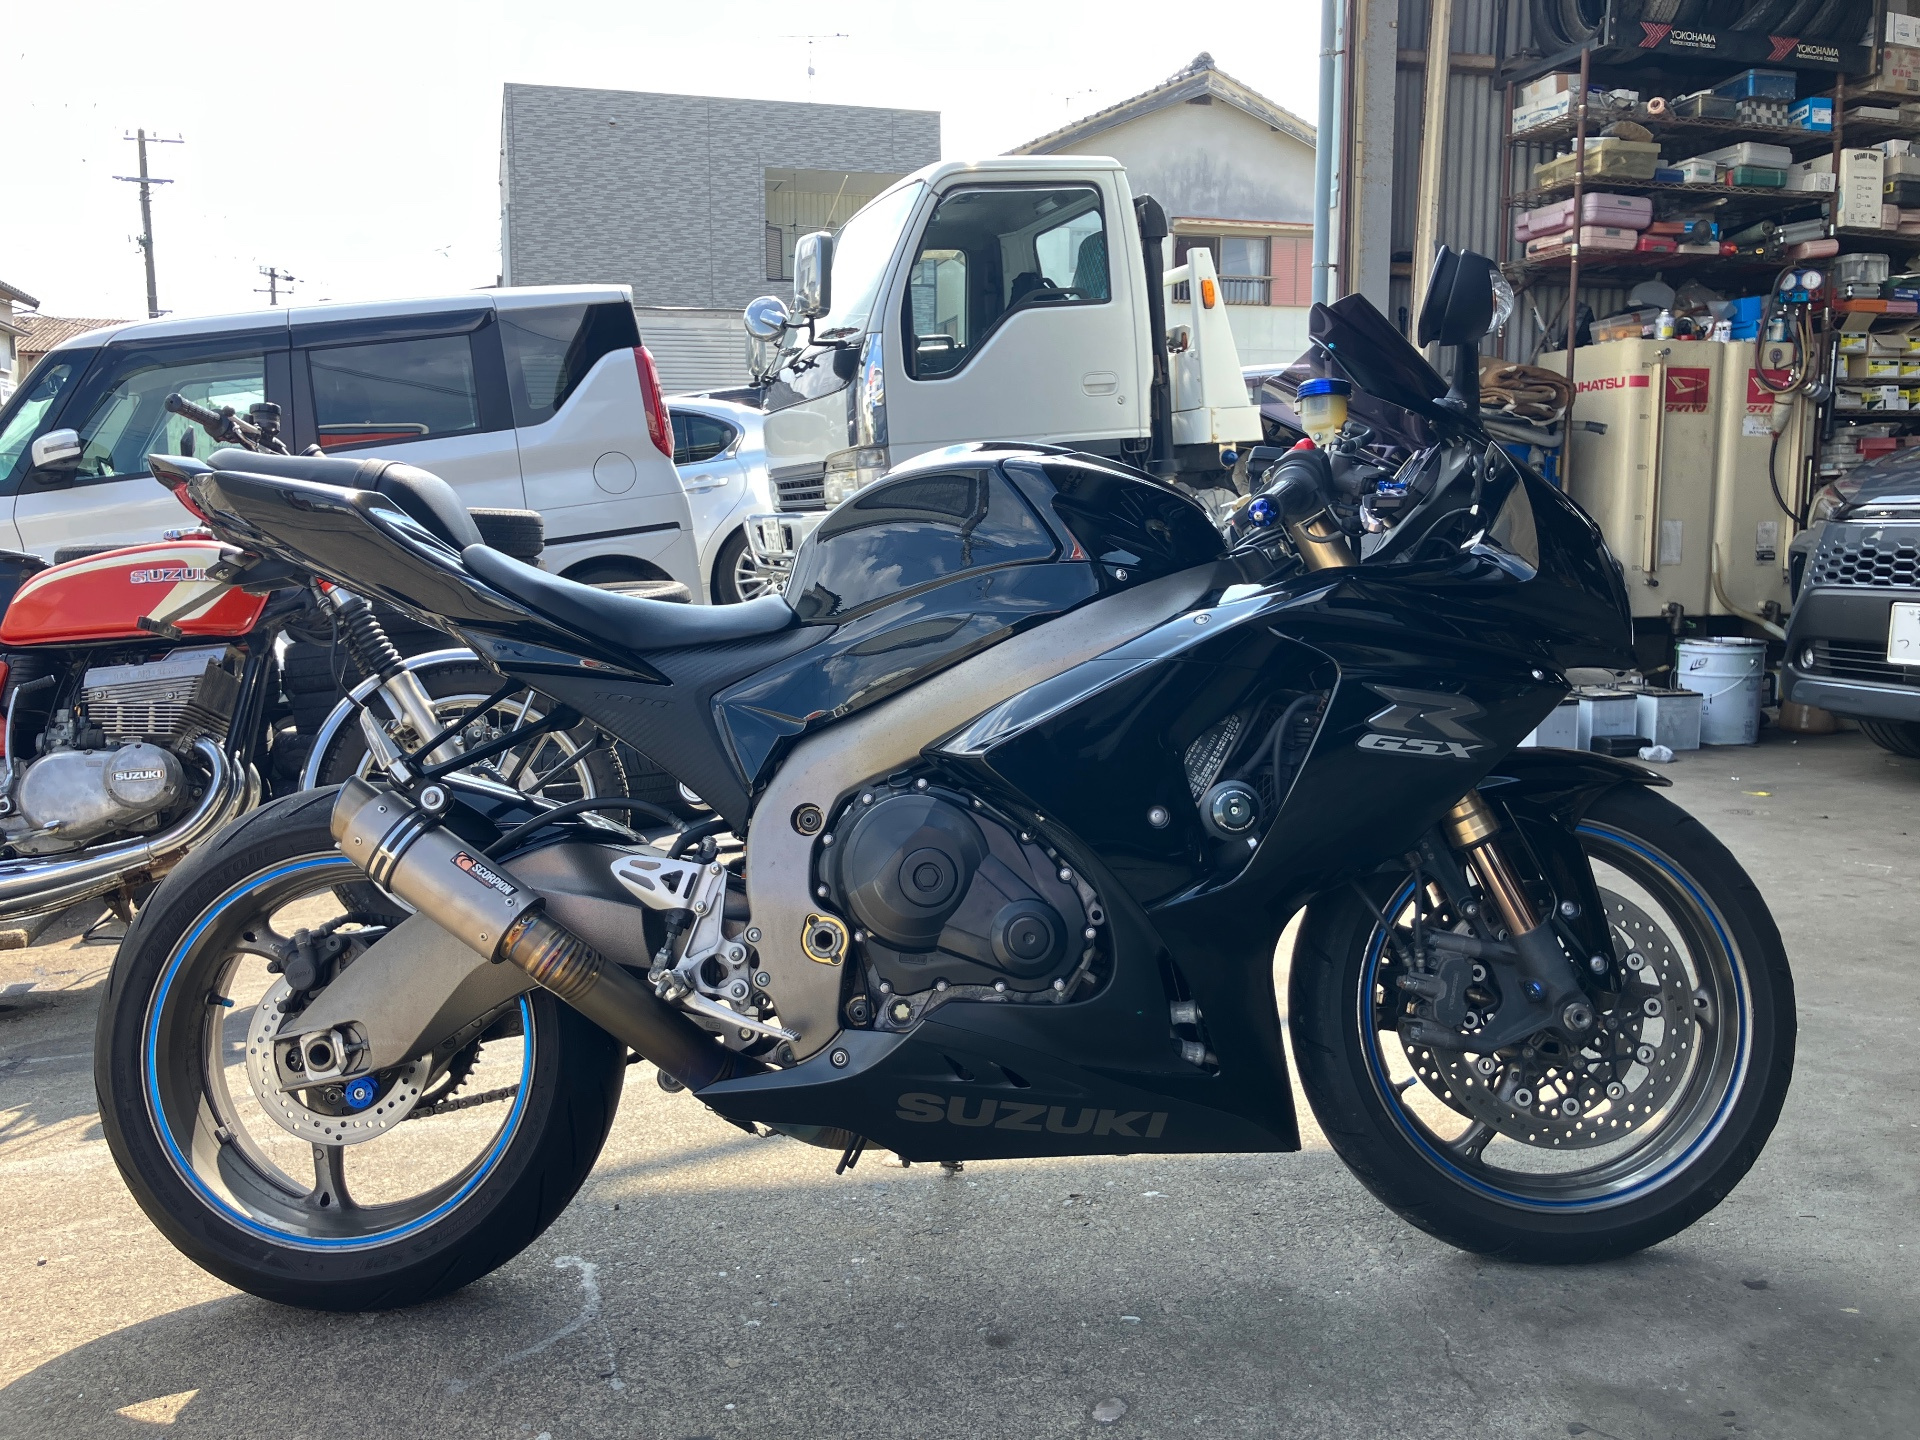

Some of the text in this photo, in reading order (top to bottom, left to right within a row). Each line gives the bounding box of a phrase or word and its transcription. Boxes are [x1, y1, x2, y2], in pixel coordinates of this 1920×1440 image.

[1670, 30, 1716, 43] YOKOHAMA
[1797, 44, 1839, 57] YOKOHAMA
[130, 567, 214, 584] SUZUK
[1357, 733, 1485, 758] GSX
[115, 770, 161, 781] SUZUKI
[471, 864, 514, 895] SCORPION
[144, 843, 279, 963] BRIDGESTONE
[895, 1092, 1169, 1139] SUZUKI
